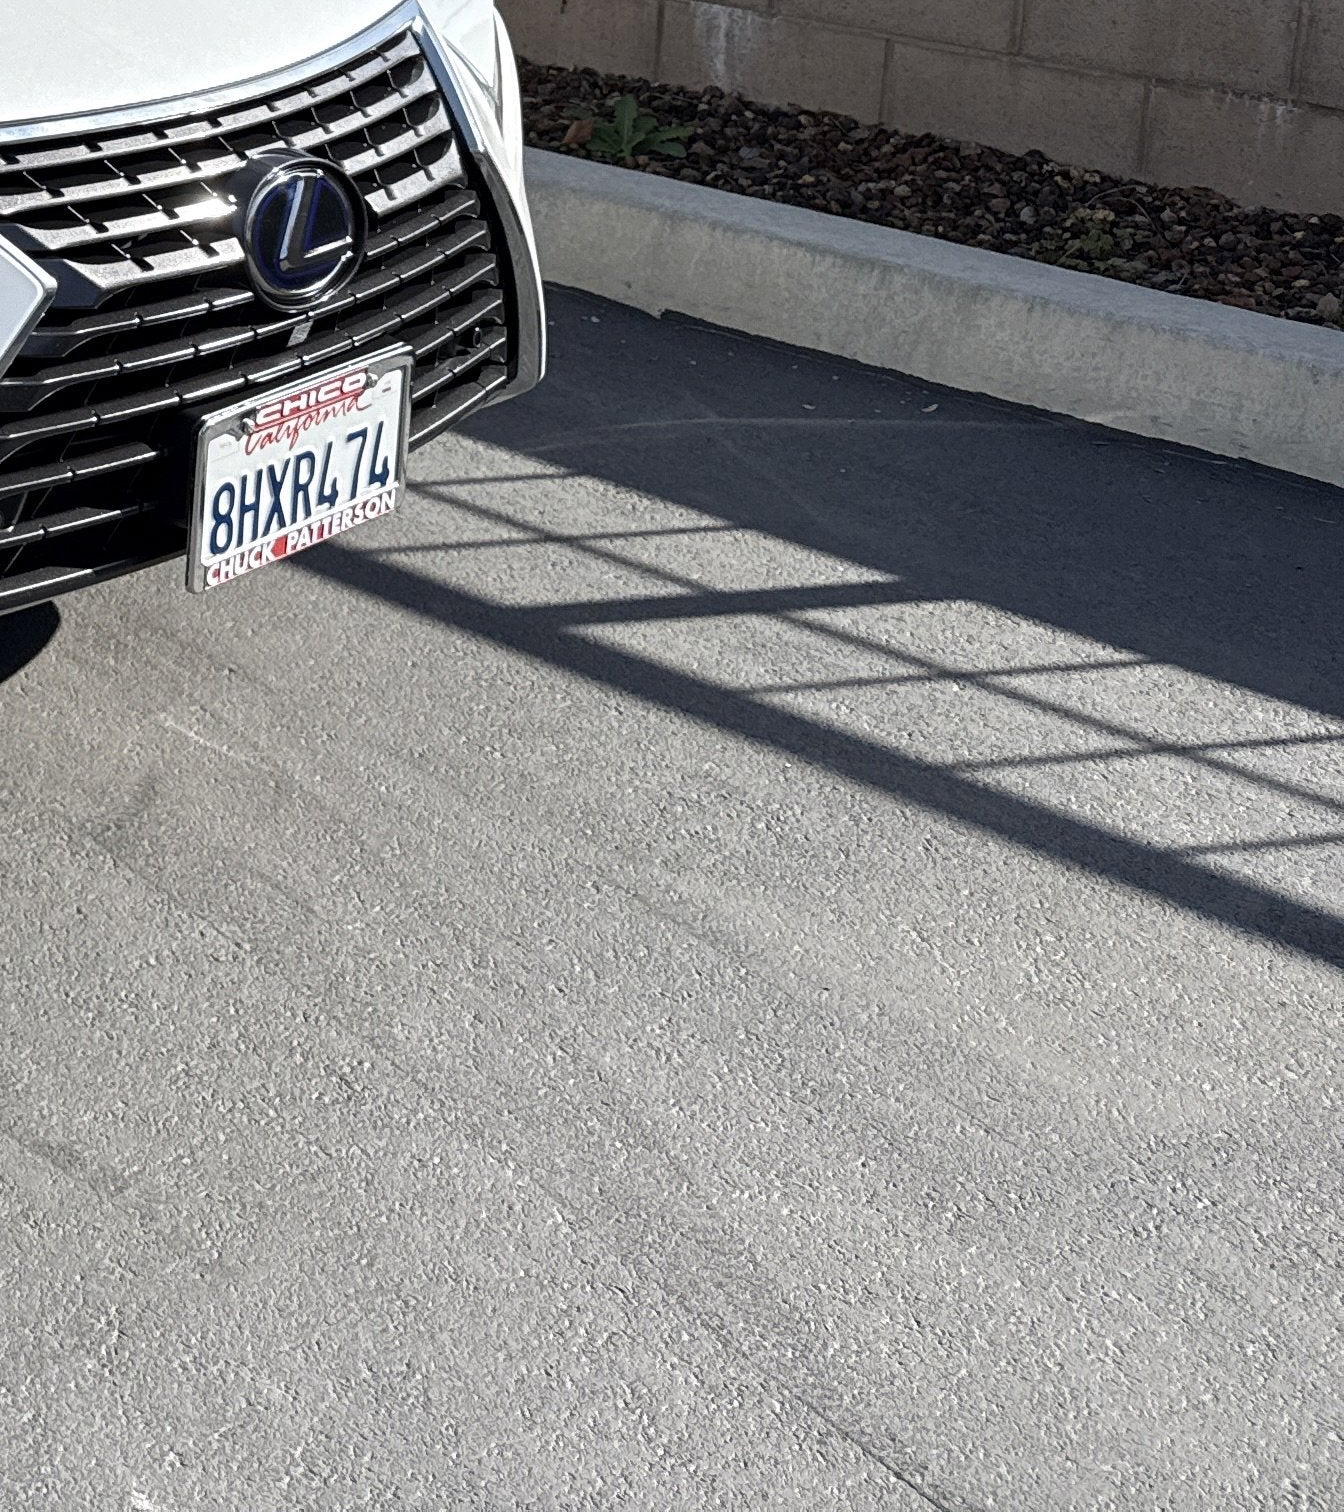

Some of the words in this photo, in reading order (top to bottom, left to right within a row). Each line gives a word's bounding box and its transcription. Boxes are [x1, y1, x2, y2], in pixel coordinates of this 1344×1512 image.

[244, 395, 373, 456] California
[255, 371, 368, 425] CHICO
[209, 420, 390, 556] 8HXR474
[206, 540, 279, 587] CHUCK
[285, 488, 397, 557] PATTERSON
